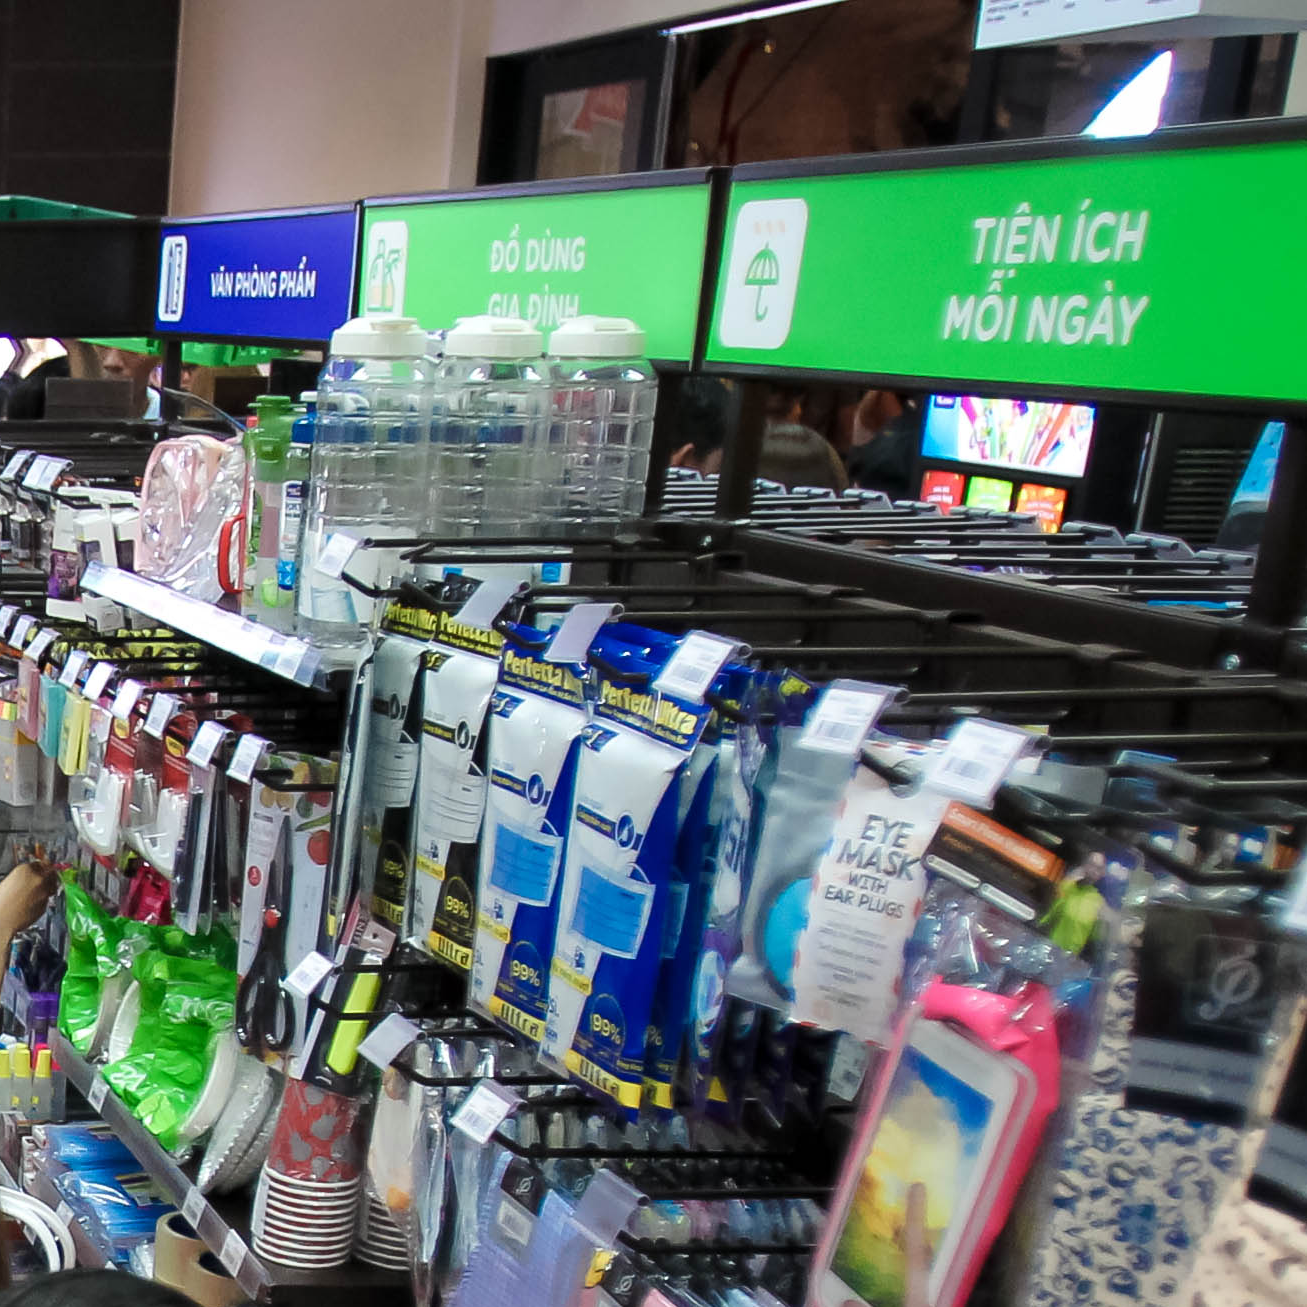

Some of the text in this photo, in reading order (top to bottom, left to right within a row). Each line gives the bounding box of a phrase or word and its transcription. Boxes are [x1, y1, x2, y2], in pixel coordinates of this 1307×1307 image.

[1070, 198, 1149, 263] ÍCH
[525, 229, 585, 272] DÙNG
[210, 265, 233, 298] VĂN
[235, 263, 277, 298] PHÒNG
[941, 269, 1151, 346] MỖI NGÀY
[860, 813, 914, 850] EYE
[836, 838, 921, 881] MASK
[848, 871, 889, 895] WITH
[444, 894, 470, 919] 99%
[824, 884, 906, 920] EAR PLUGS
[511, 959, 541, 987] 99%
[590, 1013, 622, 1045] 99%
